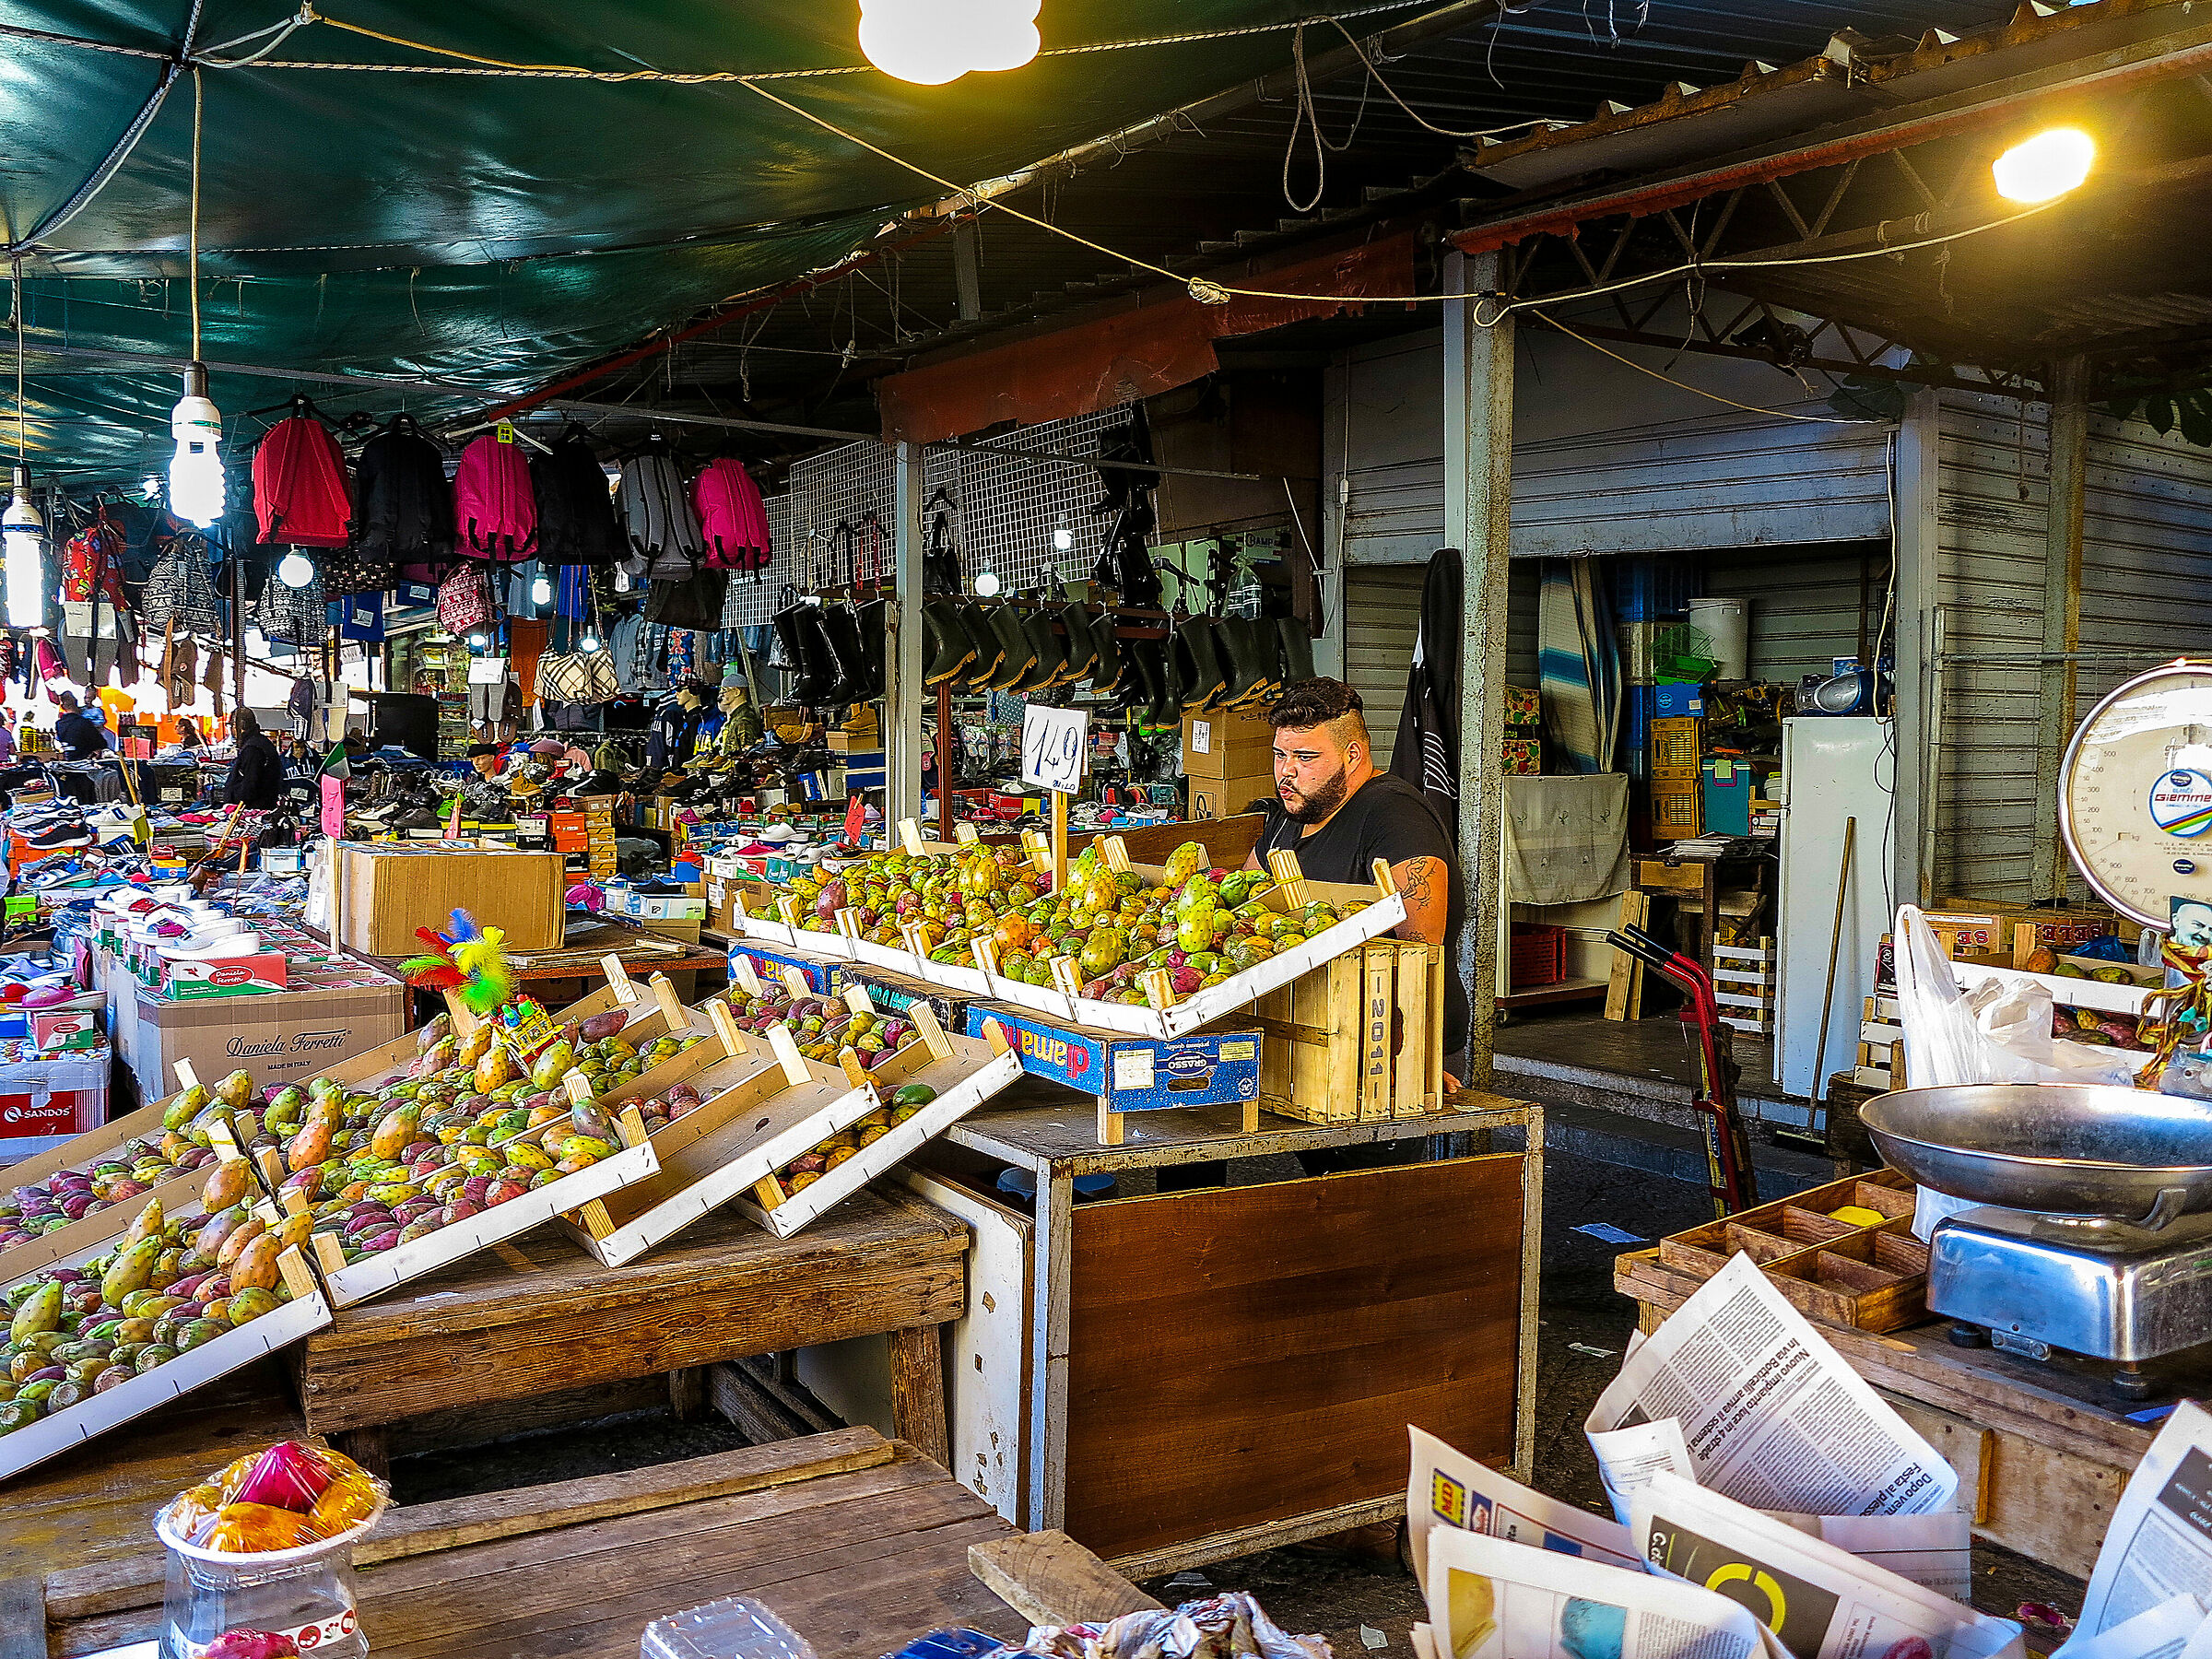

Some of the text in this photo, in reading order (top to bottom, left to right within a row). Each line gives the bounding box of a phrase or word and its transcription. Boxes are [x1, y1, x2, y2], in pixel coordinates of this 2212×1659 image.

[2155, 794, 2212, 803] Giemme
[226, 1035, 287, 1058] Daniela
[289, 1029, 347, 1053] Ferretti
[294, 1060, 312, 1068] ITALY
[1168, 1060, 1207, 1070] GRASSO
[24, 1107, 70, 1118] SANDOS
[1787, 1337, 1799, 1349] In
[1776, 1347, 1790, 1360] via
[1742, 1359, 1779, 1394] Botticelli
[1697, 1349, 1808, 1461] Nuovo impianto luce in 4 strade
[1723, 1391, 1746, 1414] arriva
[1716, 1410, 1726, 1421] il
[1690, 1417, 1722, 1447] sistema
[1895, 1464, 1919, 1487] Festa
[1885, 1484, 1898, 1497] al
[1903, 1472, 1930, 1498] Dopo
